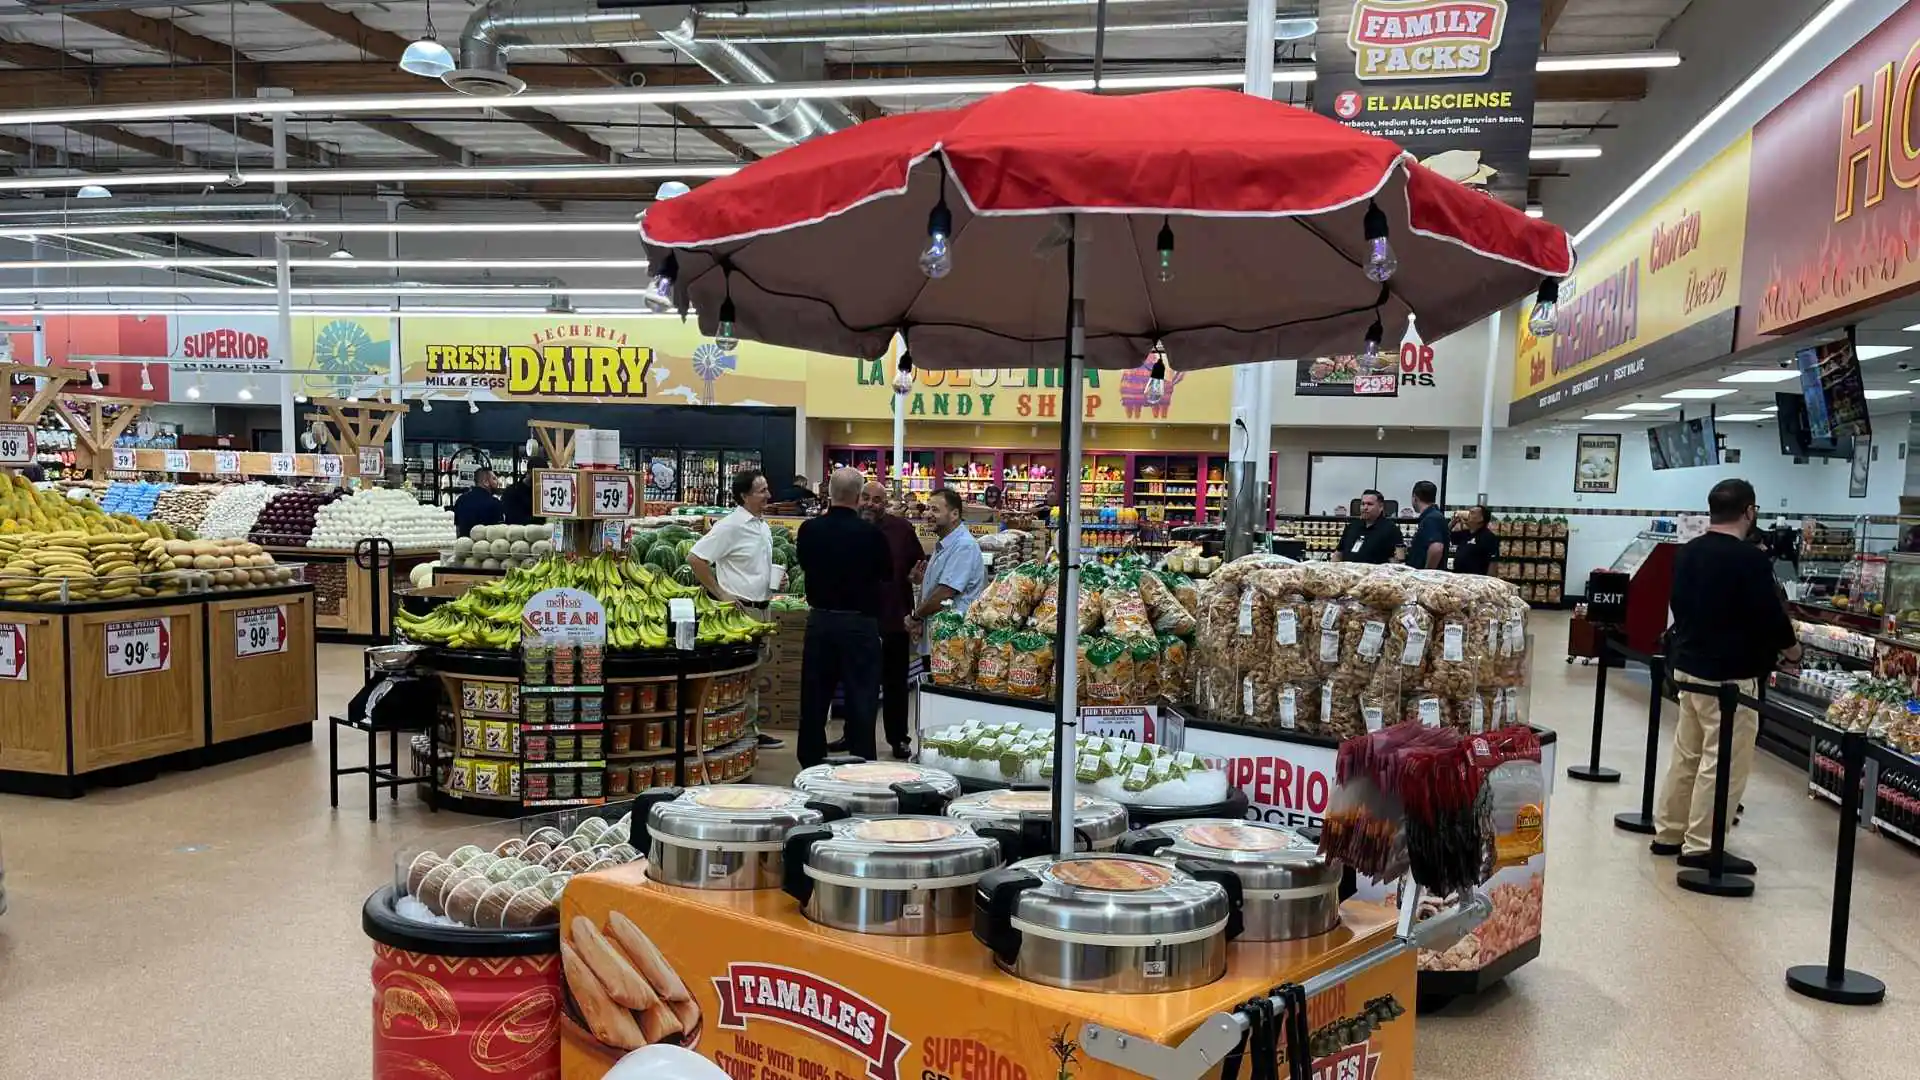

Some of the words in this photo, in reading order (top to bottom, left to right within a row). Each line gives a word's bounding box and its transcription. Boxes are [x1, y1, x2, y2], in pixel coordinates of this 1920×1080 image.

[1364, 10, 1488, 39] FAMILY
[1364, 44, 1482, 73] PACKS
[1340, 94, 1356, 116] 3
[1367, 95, 1389, 111] EL
[1391, 91, 1512, 111] JALISCIENSE
[1378, 118, 1409, 126] Medium
[1410, 117, 1429, 126] Rice,
[1430, 116, 1461, 125] Medium
[1463, 115, 1497, 124] Peruvian
[1498, 115, 1525, 124] Beans,
[1384, 128, 1406, 137] Salsa,
[1407, 127, 1414, 135] &
[1415, 127, 1425, 135] 36
[1426, 127, 1446, 135] Corn
[1447, 125, 1481, 134] Tortillas.
[183, 328, 269, 359] SUPERIOR
[531, 323, 630, 346] LECHERIA
[425, 344, 506, 374] FRESH
[507, 345, 653, 397] DAIRY
[425, 375, 455, 388] MILK
[459, 376, 468, 387] &
[471, 376, 506, 390] EGGS
[857, 358, 885, 386] LA
[1613, 364, 1627, 381] BEST
[890, 393, 996, 417] ANDY
[1016, 394, 1102, 418] SHP
[1582, 480, 1610, 489] FRESH
[1593, 592, 1624, 605] EXIT
[529, 610, 599, 626] CLEAN
[1085, 708, 1099, 716] RED
[1101, 708, 1113, 716] TAG
[738, 975, 876, 1046] TAMALES
[713, 1049, 757, 1080] STONE
[734, 1033, 763, 1062] MADE
[766, 1045, 795, 1073] WITH
[798, 1056, 833, 1080] 100%
[922, 1036, 1028, 1080] SUPERIOR
